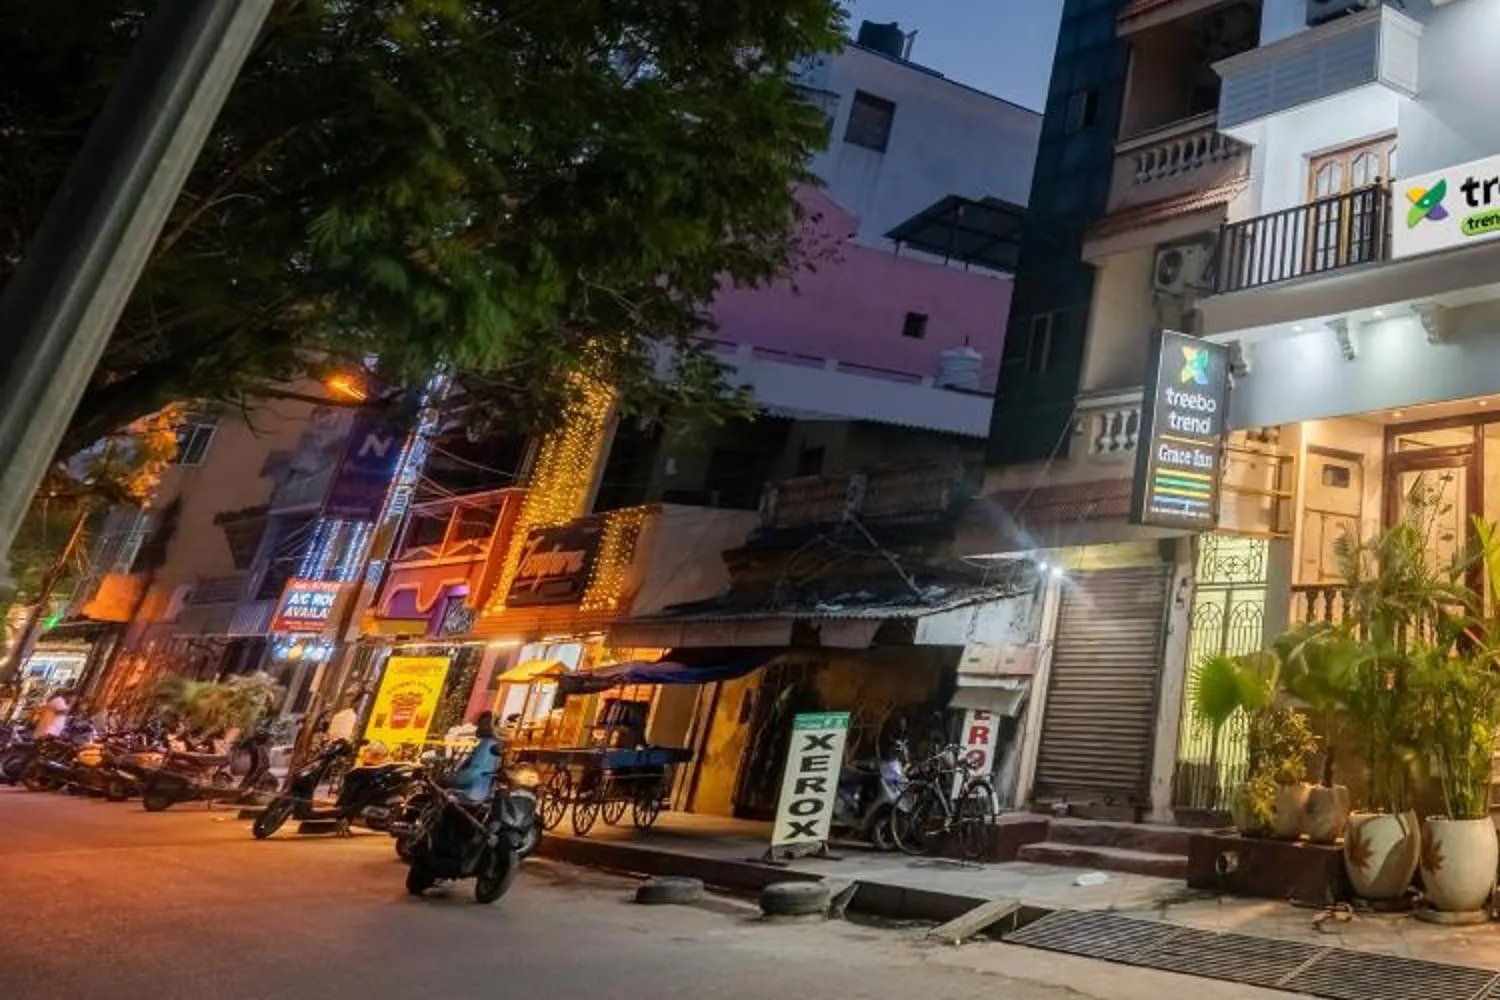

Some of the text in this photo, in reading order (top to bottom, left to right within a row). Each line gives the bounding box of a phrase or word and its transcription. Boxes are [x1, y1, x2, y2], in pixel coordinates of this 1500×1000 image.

[1165, 387, 1216, 413] treebo
[1168, 411, 1212, 434] trend
[1158, 444, 1191, 466] Grace
[283, 606, 330, 619] AVAILA
[784, 733, 837, 840] XEROX
